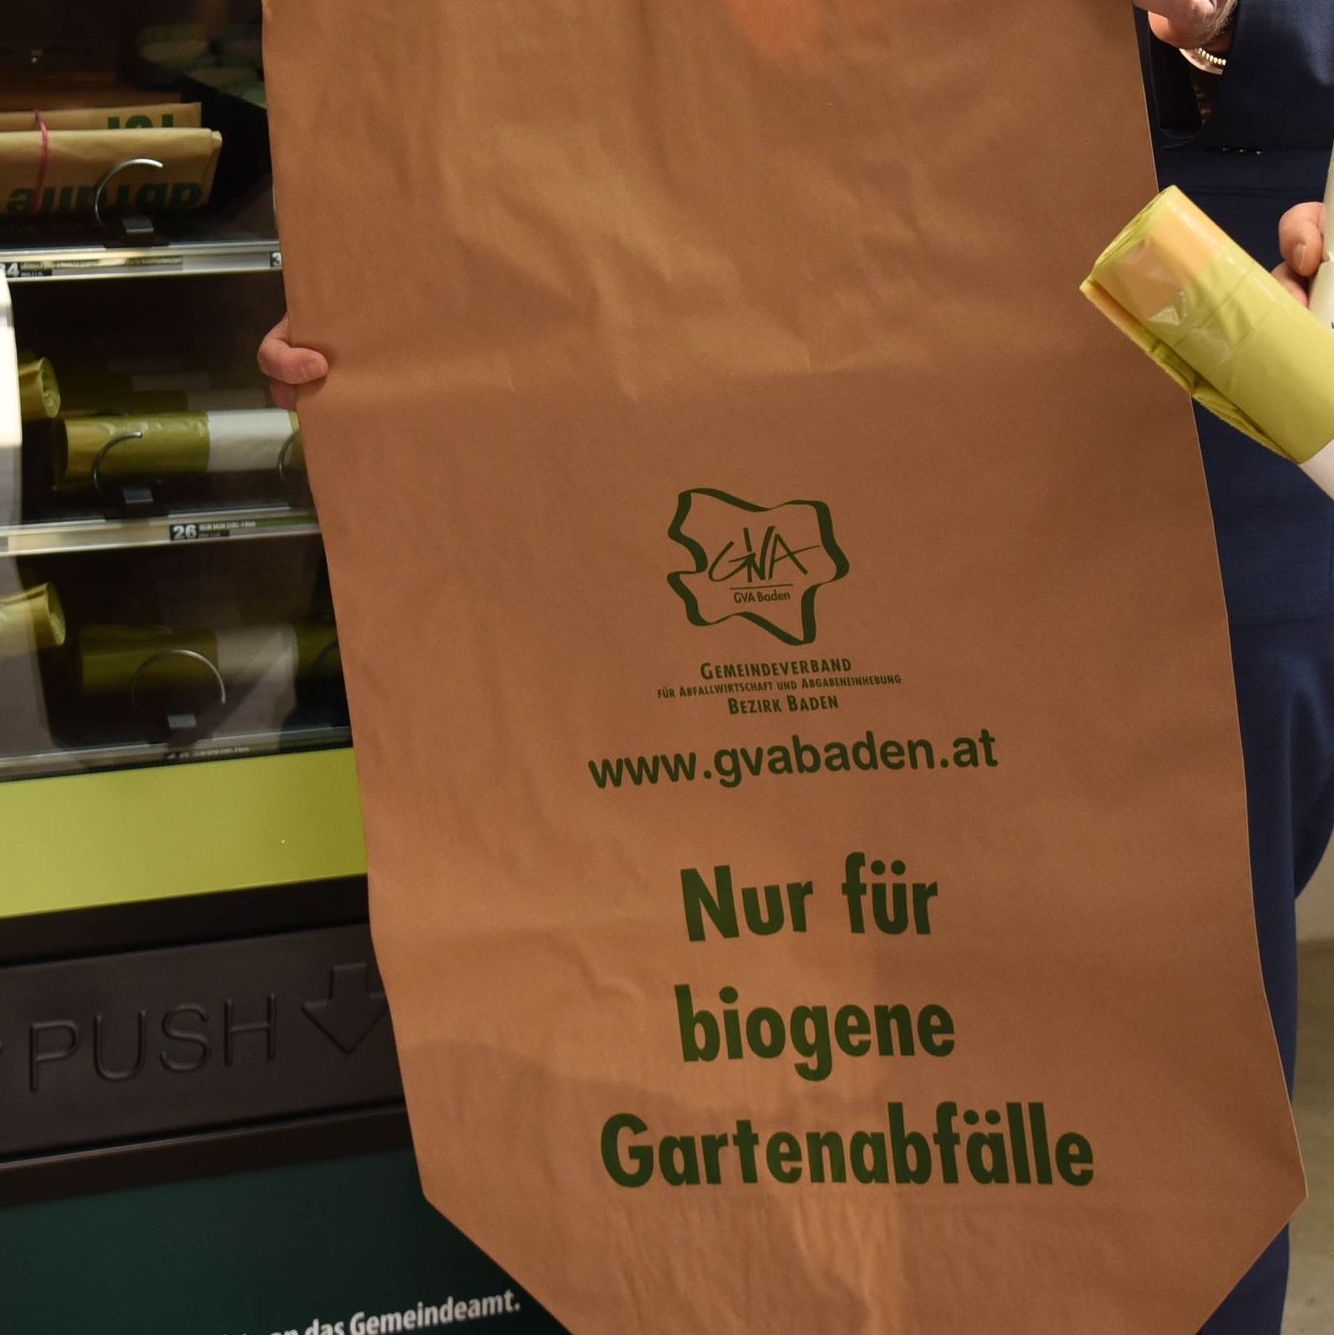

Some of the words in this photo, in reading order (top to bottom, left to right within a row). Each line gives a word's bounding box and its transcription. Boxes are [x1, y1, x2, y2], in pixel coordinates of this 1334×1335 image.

[172, 524, 198, 540] 26
[708, 526, 820, 583] GVA
[733, 591, 755, 604] GVA
[757, 589, 791, 602] Baden
[679, 682, 773, 698] ABFALLWIRTSCHAFT
[777, 680, 798, 691] UND
[700, 658, 852, 680] GEMEINDEVERBAND
[728, 697, 782, 715] BEZIRK
[786, 695, 839, 713] BADEN
[587, 728, 999, 789] www.gvabaden.at
[680, 865, 814, 942] Nur
[842, 852, 938, 936] für
[28, 993, 276, 1093] PUSH
[674, 984, 956, 1082] biogene
[600, 1101, 1095, 1188] Gartenabfälle
[350, 1289, 521, 1334] Gemeindeamt.
